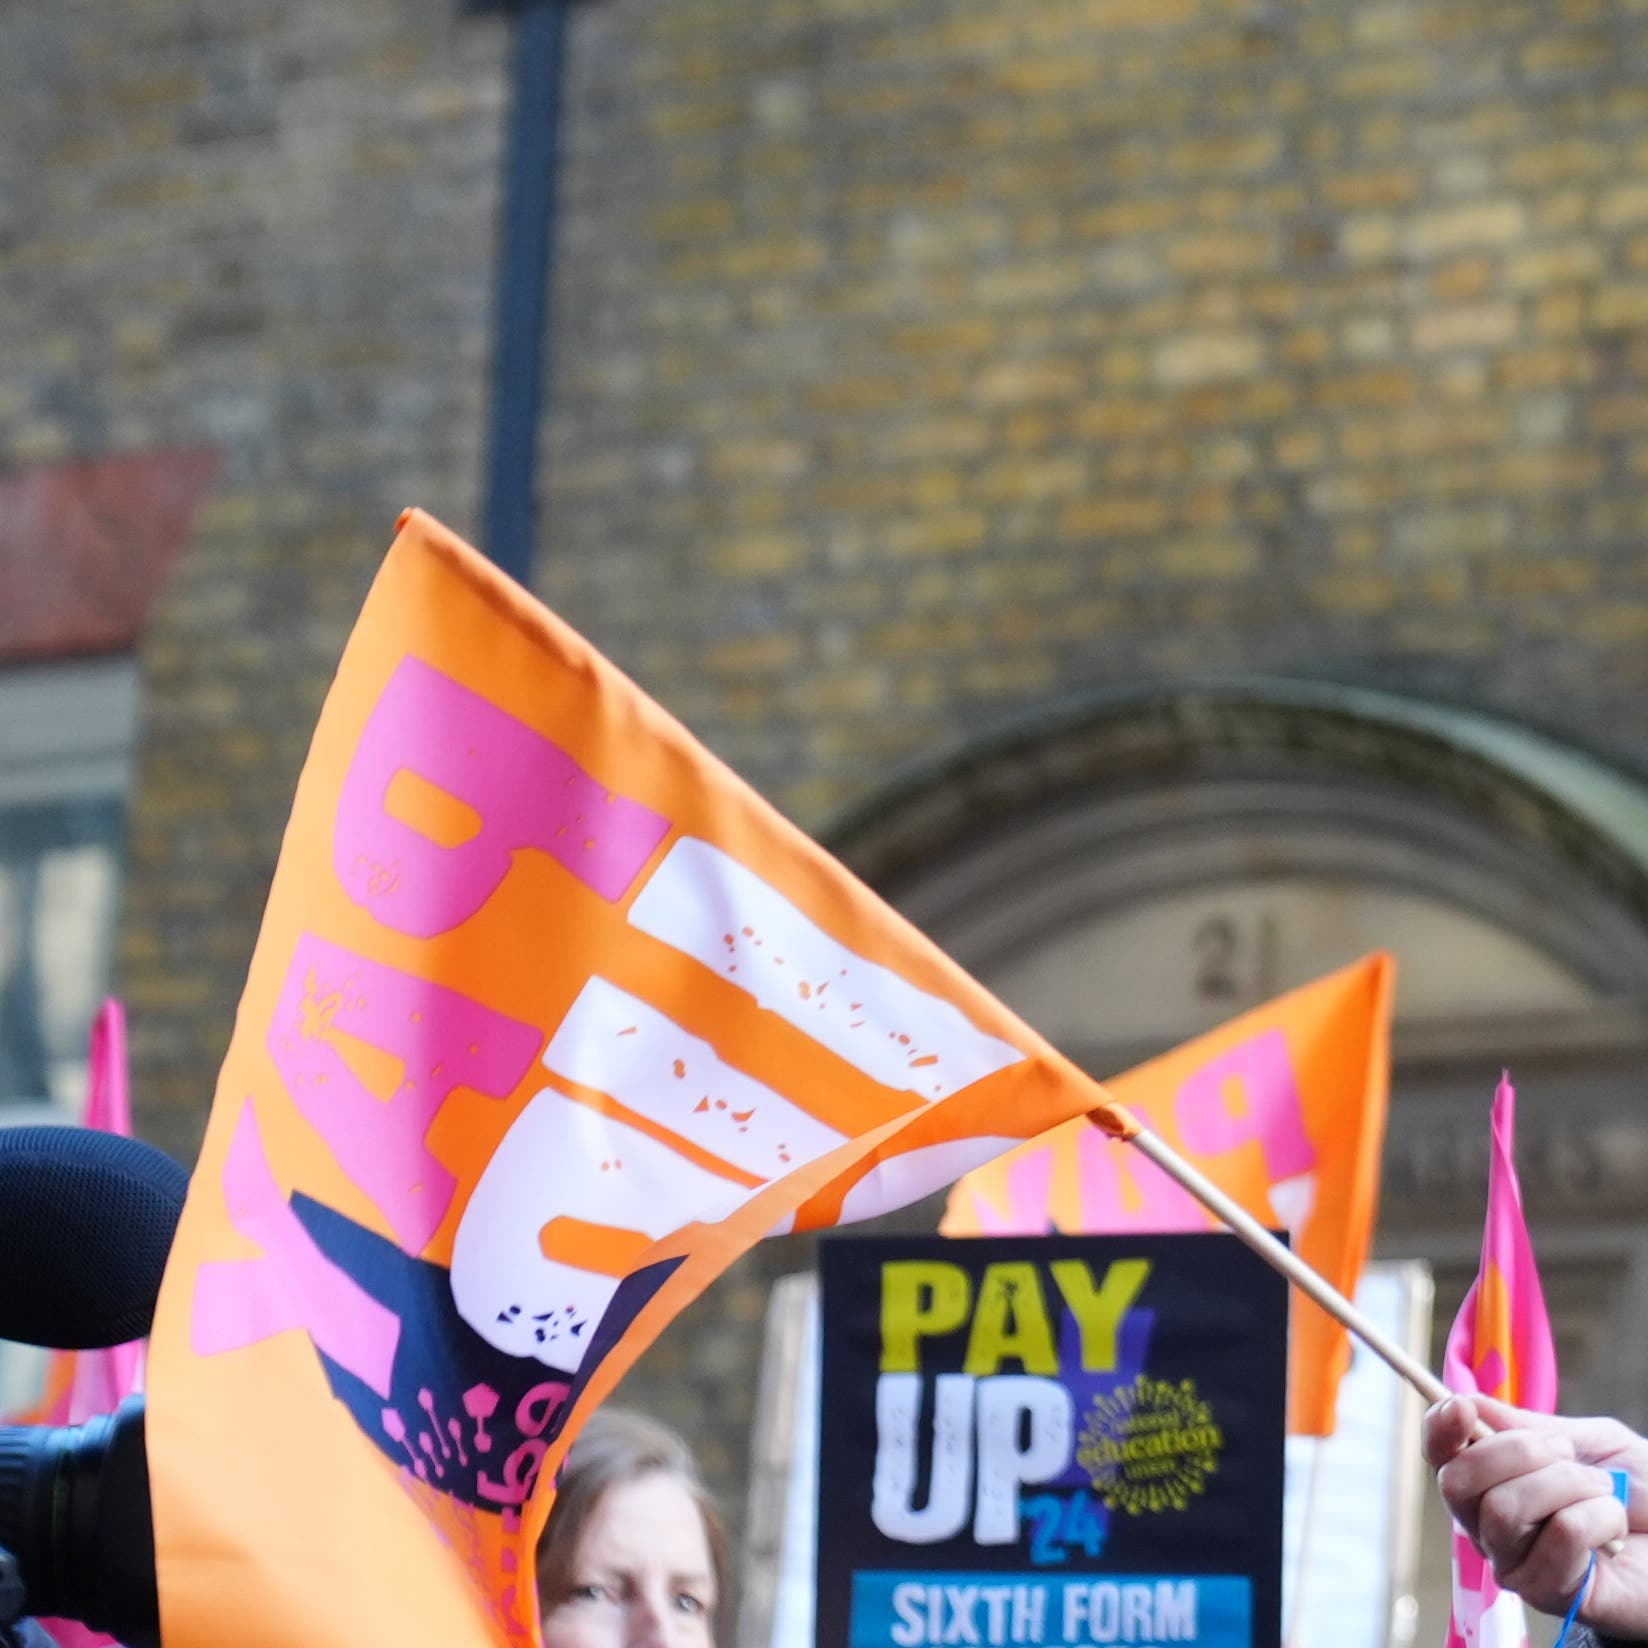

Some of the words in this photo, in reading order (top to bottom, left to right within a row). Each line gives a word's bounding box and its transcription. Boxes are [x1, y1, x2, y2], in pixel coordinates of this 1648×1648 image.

[880, 1258, 1153, 1376] PAY
[871, 1371, 1074, 1546] UP
[891, 1582, 1045, 1648] SIXTH
[1063, 1580, 1198, 1644] FORM
